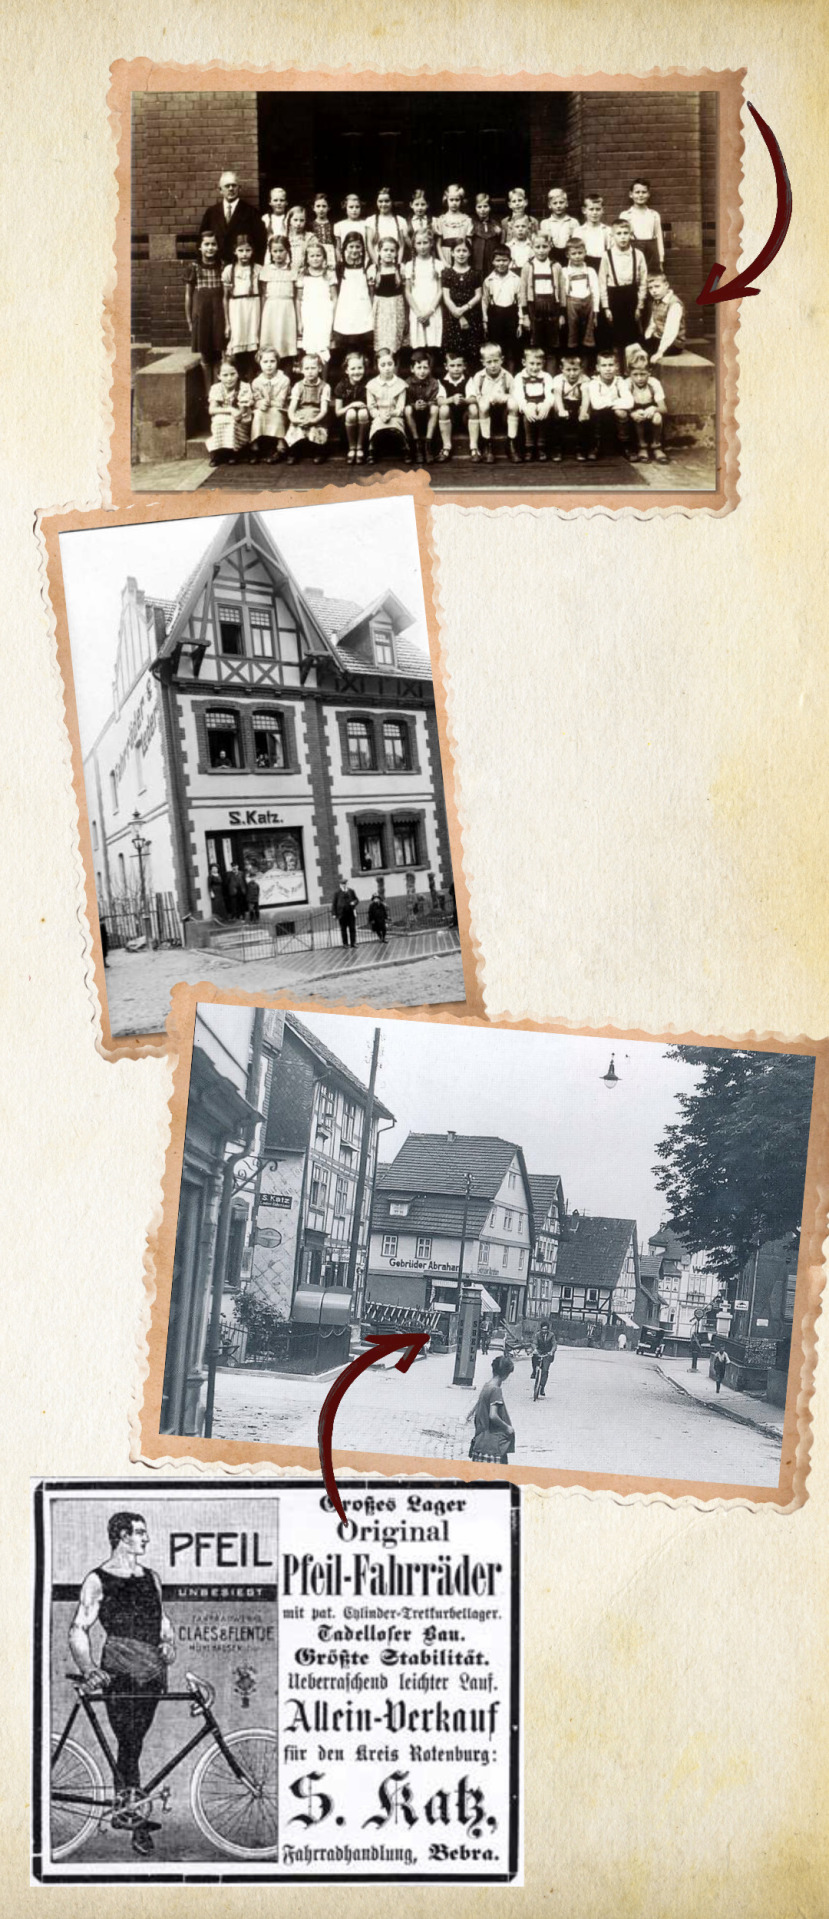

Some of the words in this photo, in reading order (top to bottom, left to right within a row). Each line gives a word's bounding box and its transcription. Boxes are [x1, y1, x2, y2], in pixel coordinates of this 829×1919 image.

[270, 1195, 290, 1204] Katz
[389, 1258, 427, 1270] Gebrüder
[407, 1495, 467, 1516] Lager
[337, 1519, 449, 1548] Original
[170, 1532, 273, 1567] PFEIL
[283, 1554, 503, 1597] Pfeil-Fahrräder
[178, 1588, 263, 1598] UNBESIEGT
[283, 1607, 304, 1619] mit
[312, 1608, 336, 1621] pat.
[179, 1625, 218, 1641] CLAES
[422, 1624, 466, 1646] Bau.
[294, 1648, 370, 1669] Größte
[380, 1648, 490, 1667] Stabilität.
[399, 1671, 449, 1693] leichter
[459, 1671, 498, 1693] Lauf.
[284, 1698, 501, 1741] Allein-Verkauf
[283, 1745, 307, 1763] für
[317, 1744, 344, 1761] den
[355, 1744, 399, 1762] Kreis
[409, 1743, 497, 1766] Rotenburg:
[287, 1770, 345, 1830] S.
[282, 1844, 418, 1865] Fahrradhandlung,
[428, 1843, 500, 1862] Bebra.
